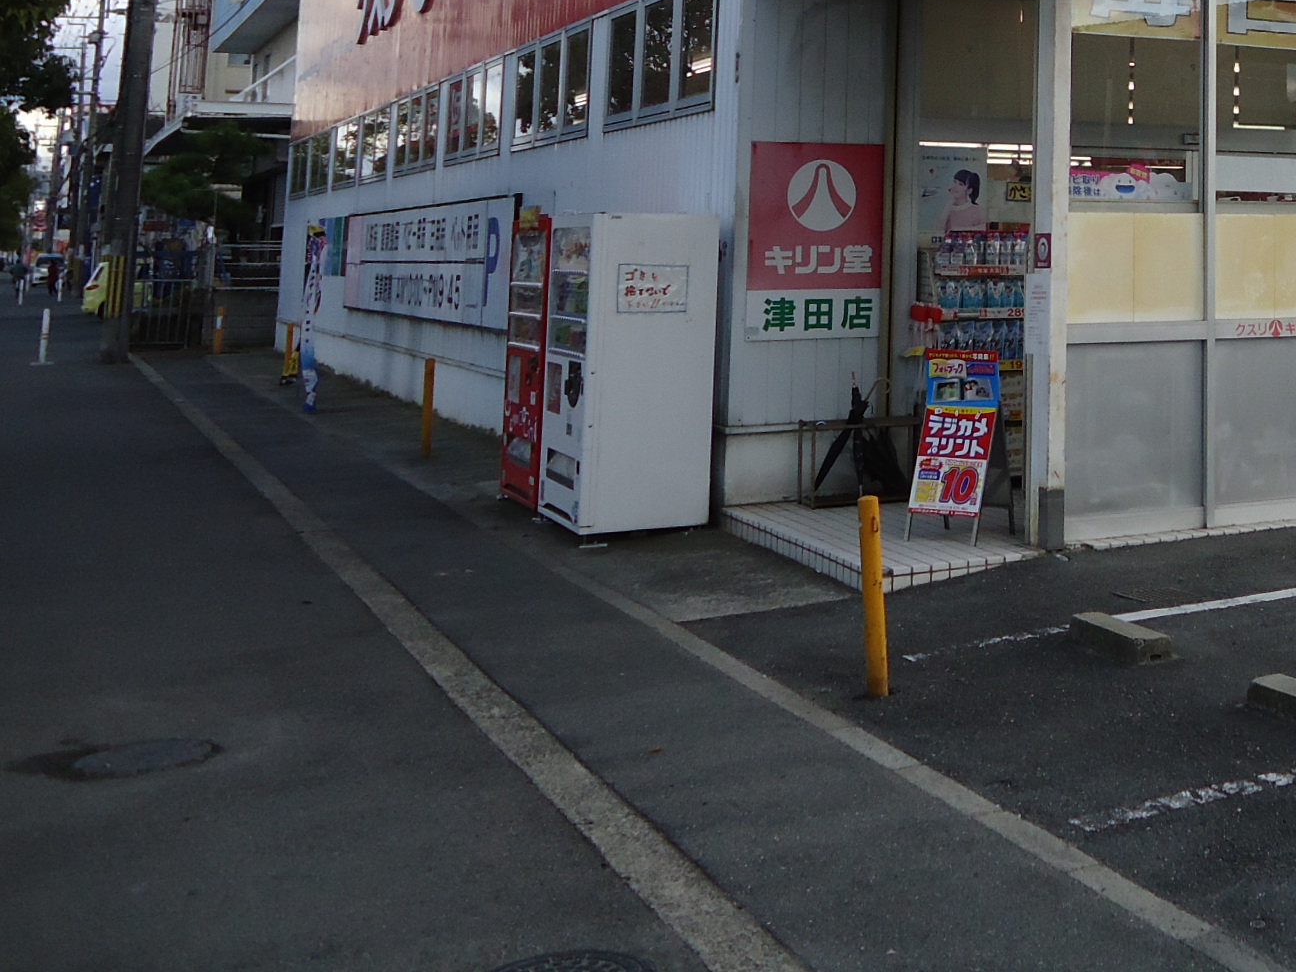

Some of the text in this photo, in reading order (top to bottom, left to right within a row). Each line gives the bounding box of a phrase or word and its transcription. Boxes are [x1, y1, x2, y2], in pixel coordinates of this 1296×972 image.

[482, 216, 500, 307] P
[764, 245, 873, 274] キリン堂
[762, 296, 873, 332] 津田店
[1235, 324, 1267, 337] クスリ
[928, 413, 989, 438] デジカメ
[925, 438, 985, 458] プリント
